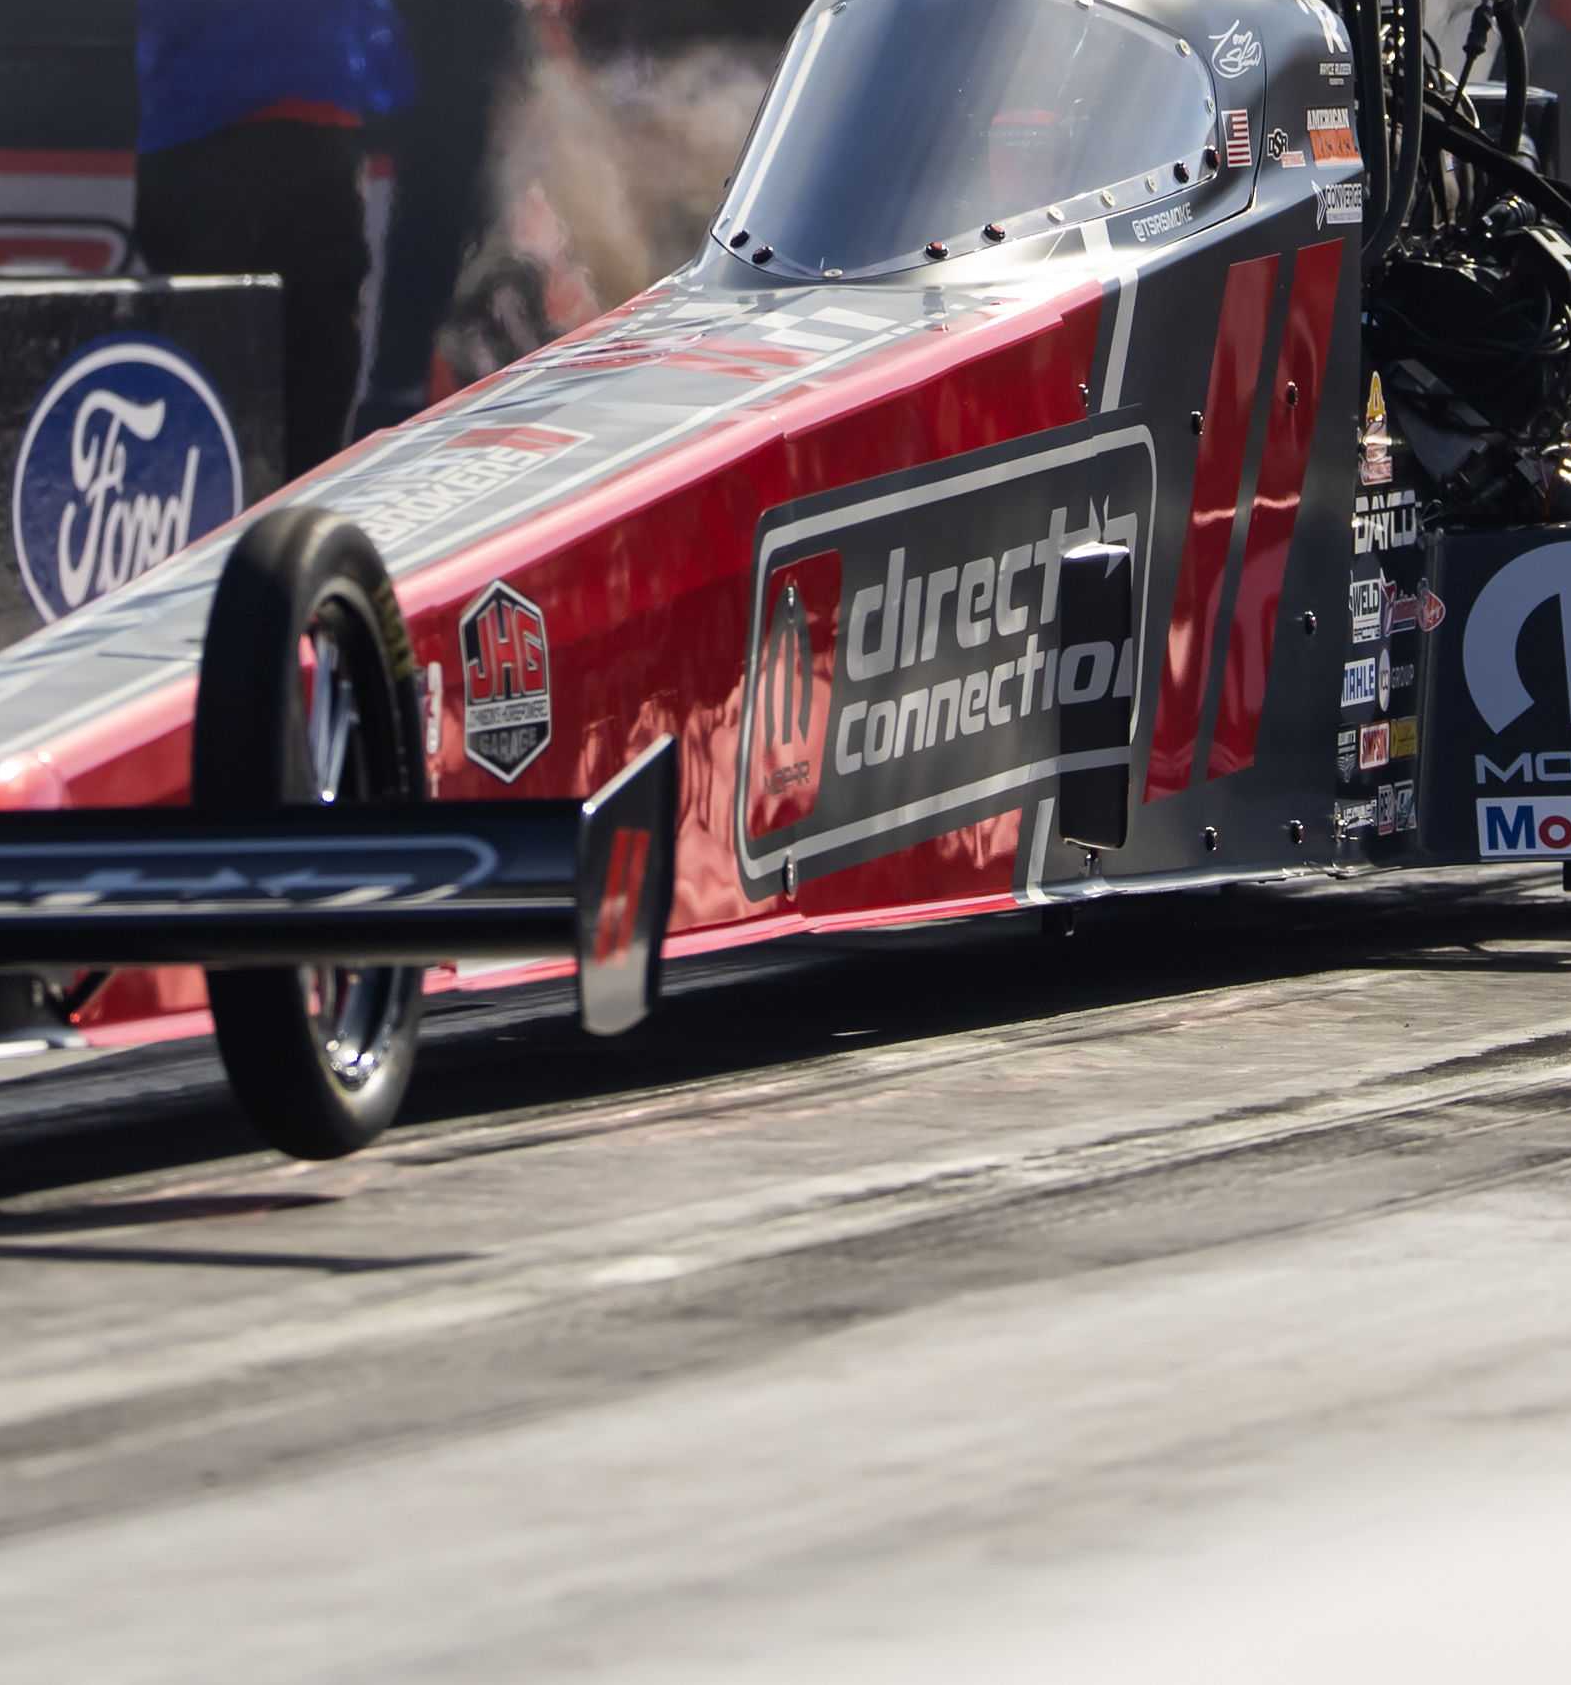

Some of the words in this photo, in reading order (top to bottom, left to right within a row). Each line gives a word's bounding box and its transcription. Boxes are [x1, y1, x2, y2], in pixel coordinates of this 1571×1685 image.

[1307, 108, 1350, 130] AMERICAN
[1268, 129, 1288, 159] DSR
[1325, 185, 1363, 211] CONVERGE
[1132, 201, 1193, 243] @TSRSMOKE
[56, 389, 198, 608] Ford
[846, 502, 1098, 681] direct
[1353, 582, 1380, 618] WELD
[480, 726, 538, 765] GARAGE
